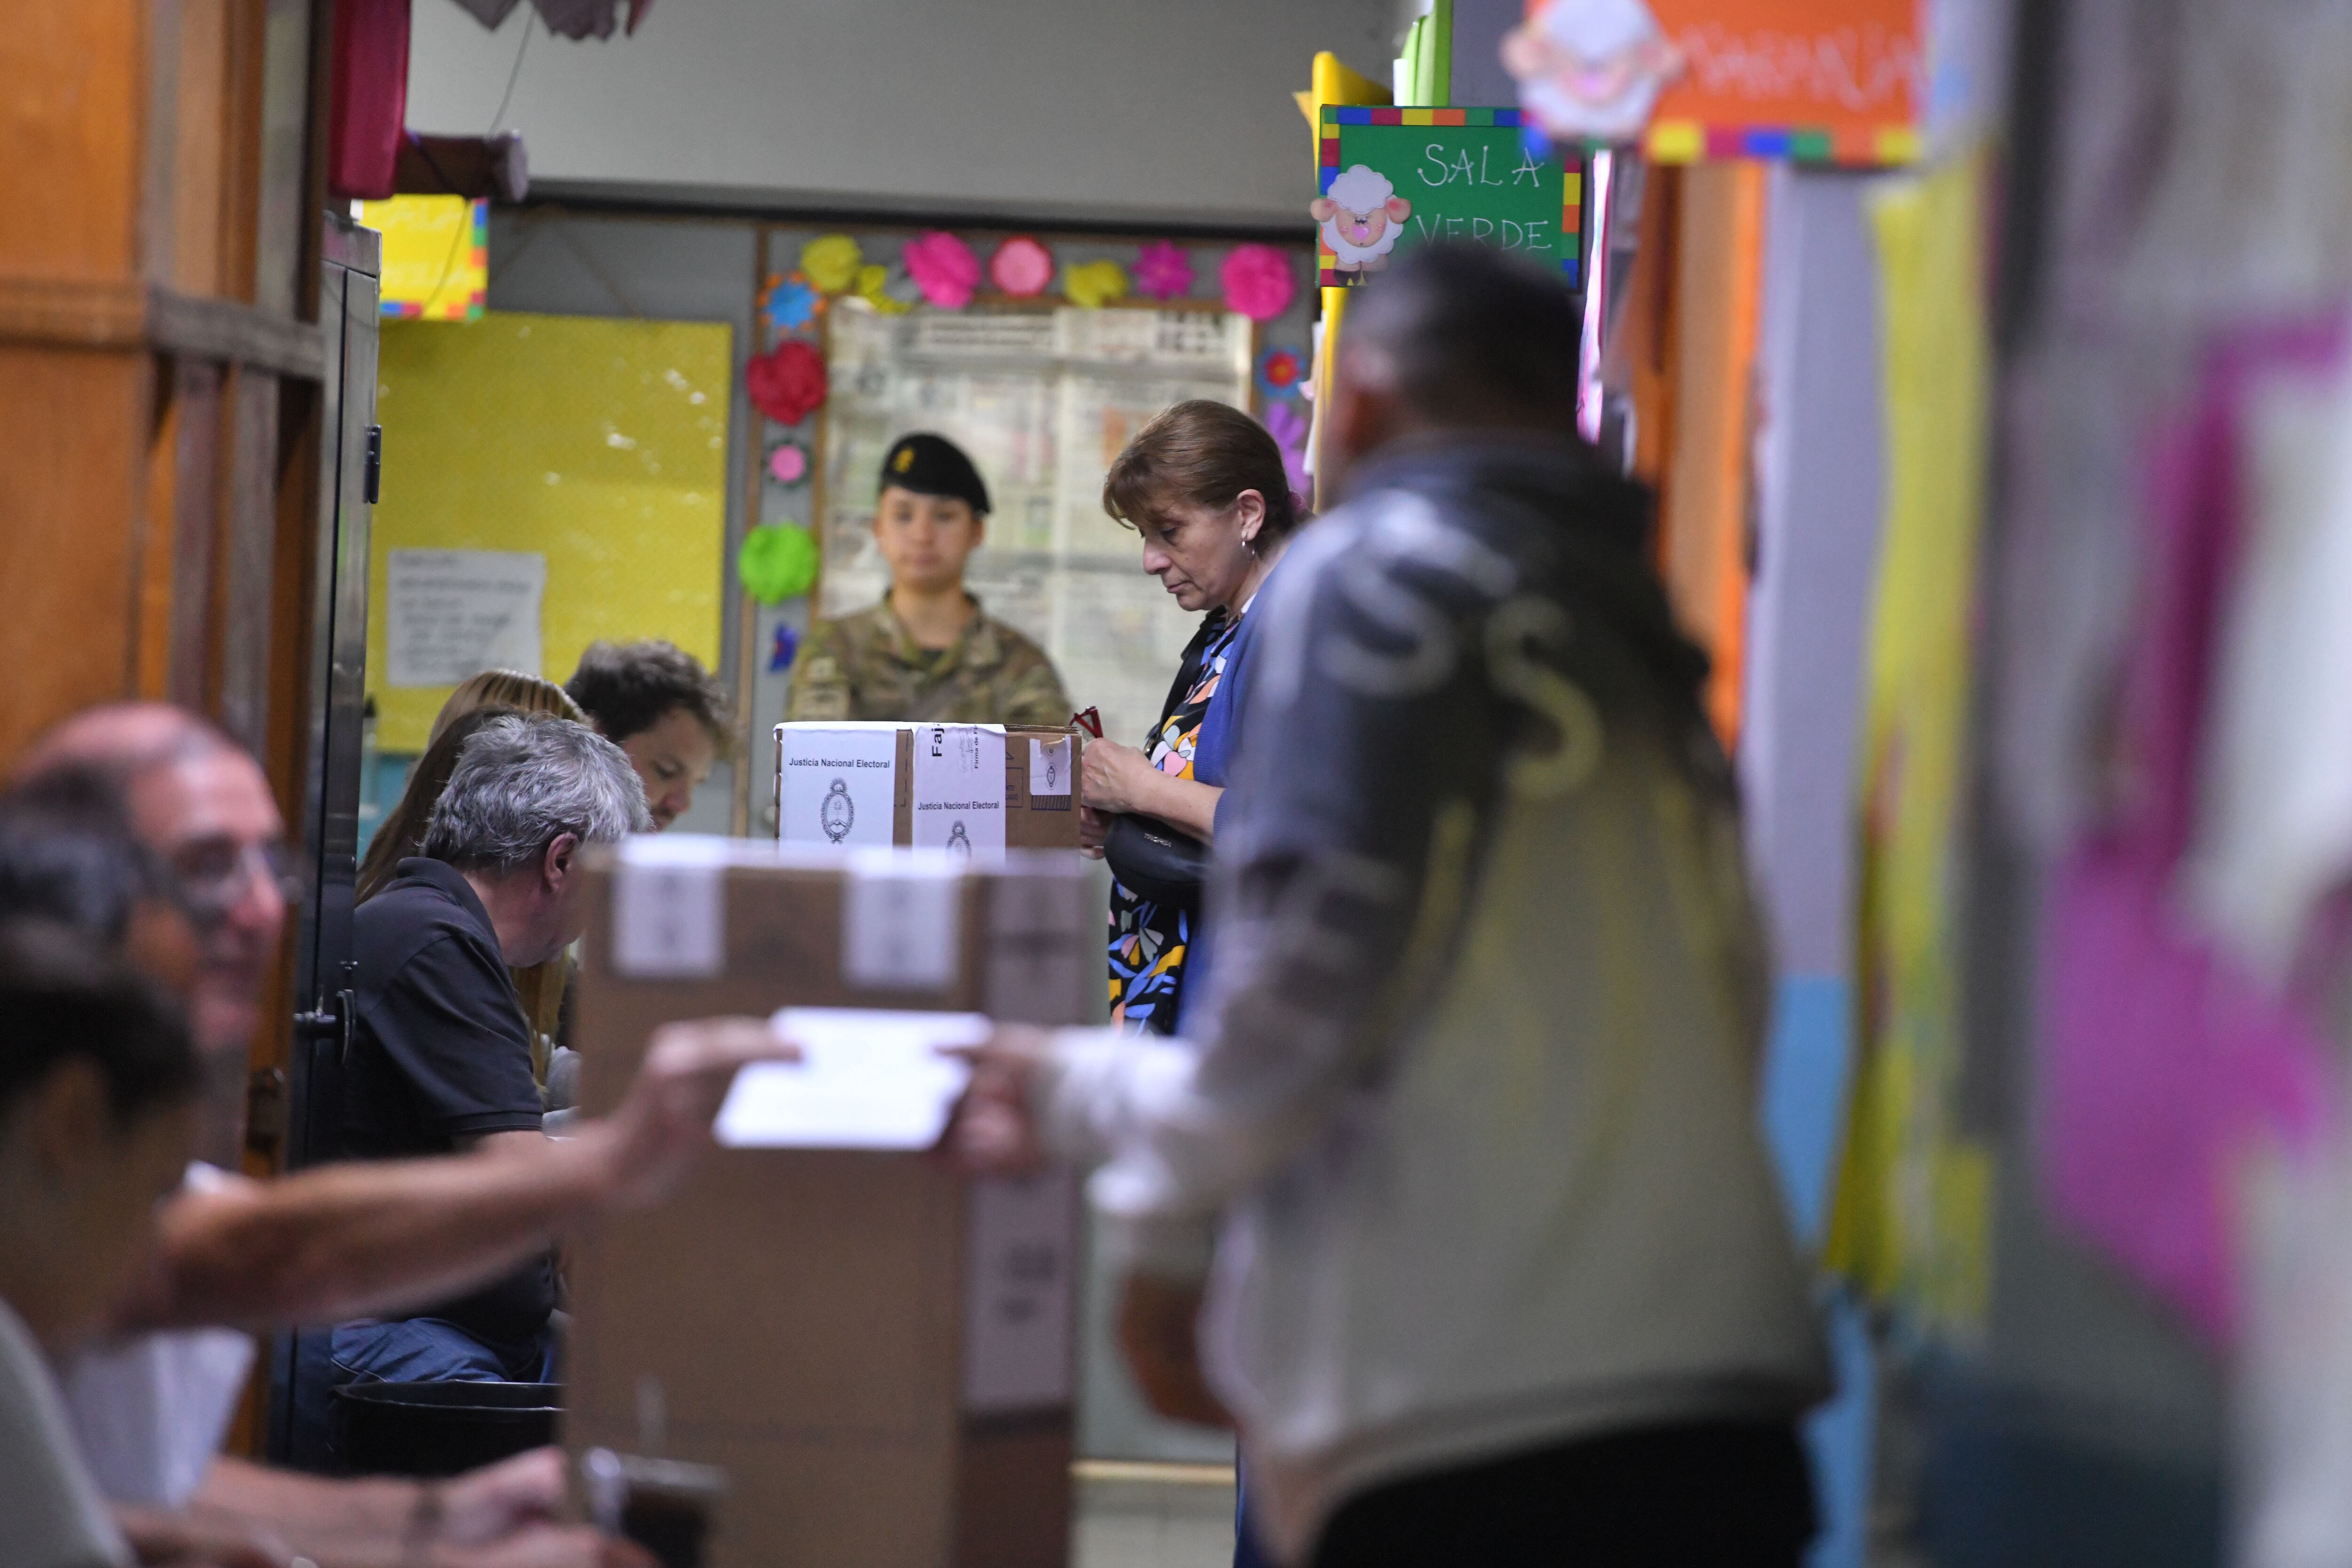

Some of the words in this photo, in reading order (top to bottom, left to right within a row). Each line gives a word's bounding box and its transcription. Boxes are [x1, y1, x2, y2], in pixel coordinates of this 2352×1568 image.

[1417, 143, 1545, 187] SALA
[1416, 214, 1552, 250] VERDE
[974, 737, 978, 746] de
[789, 757, 819, 766] Justicia
[821, 758, 854, 767] Nacional
[856, 759, 890, 768] Electoral
[918, 802, 942, 810] Justicia
[944, 801, 971, 810] Nacional
[972, 801, 1000, 809] Electoral
